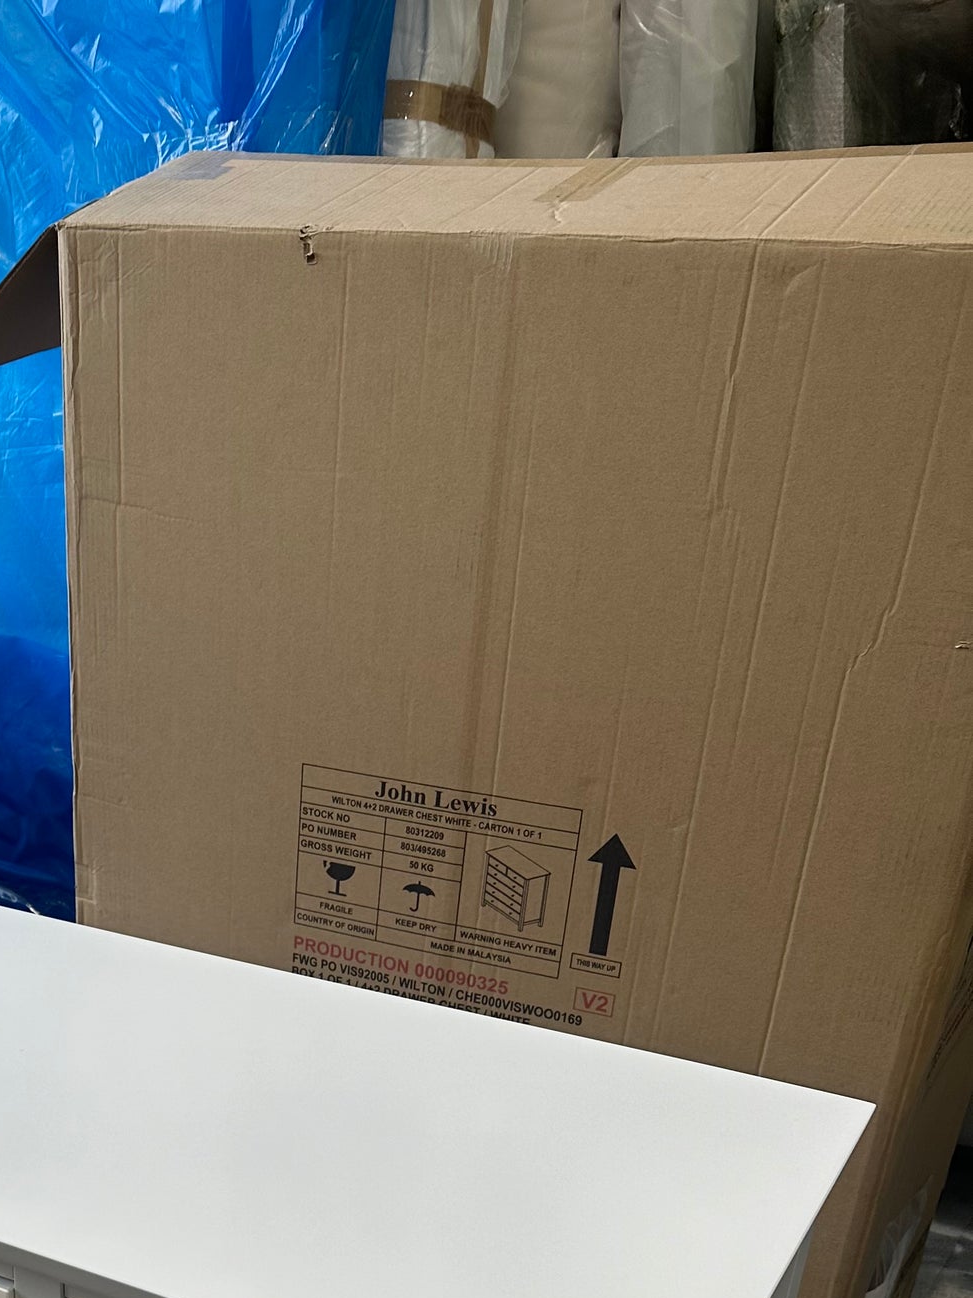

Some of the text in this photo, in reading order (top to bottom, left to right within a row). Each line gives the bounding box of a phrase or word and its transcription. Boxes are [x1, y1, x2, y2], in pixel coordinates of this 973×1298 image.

[375, 781, 497, 817] John Lewis
[303, 807, 350, 823] STOCK NO
[332, 796, 361, 808] WILTON
[363, 802, 377, 811] 4+2
[379, 804, 414, 818] DRAWER
[416, 811, 443, 822] CHEST
[445, 816, 471, 828] WHITE
[478, 821, 514, 835] CARTON
[523, 829, 535, 839] OF
[301, 823, 357, 840] PO NUMBER
[405, 826, 444, 841] 80312209
[300, 839, 372, 860] GROSS WEIGHT
[409, 860, 434, 873] 50 KG
[319, 901, 353, 915] FRAGILE
[297, 912, 374, 936] COUNTRY OF ORIGIN
[395, 918, 437, 933] KEEP DRY
[430, 941, 512, 965] MADE IN MALAYSIA
[460, 931, 557, 957] WARNING HEAVY ITEM
[293, 935, 509, 995] PRODUCTION 000090325
[576, 958, 590, 968] THIS
[591, 962, 606, 970] WAY
[291, 966, 315, 979] BOX
[383, 986, 436, 1005] DRAWER
[292, 953, 318, 967] FWG
[321, 960, 337, 971] PO
[339, 963, 390, 985] VIS92005
[399, 977, 445, 997] WILTON
[581, 991, 609, 1012] V2
